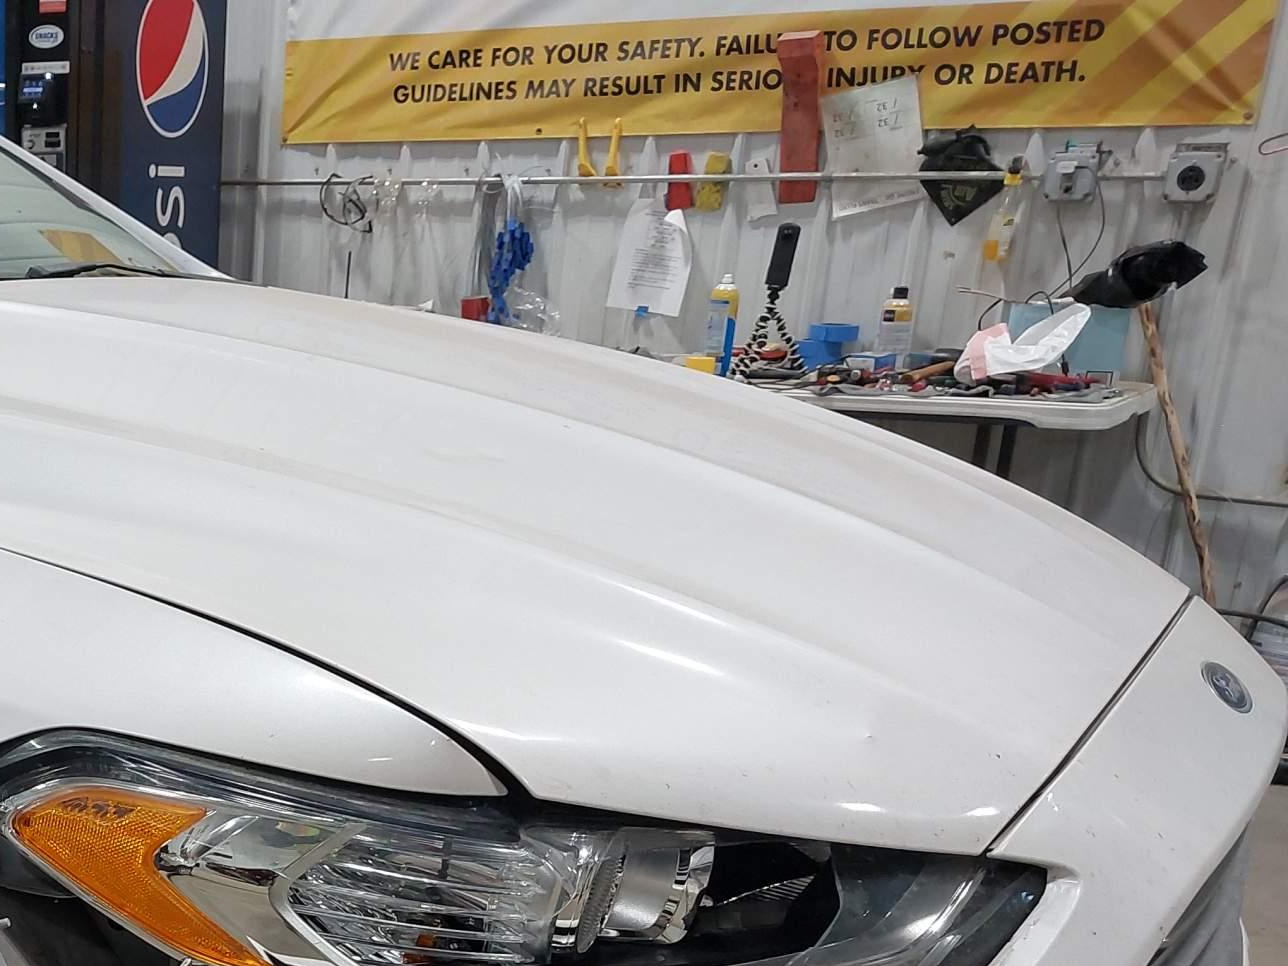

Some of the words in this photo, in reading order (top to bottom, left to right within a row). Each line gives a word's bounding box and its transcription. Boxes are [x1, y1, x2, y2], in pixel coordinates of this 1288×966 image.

[389, 51, 421, 71] WE
[428, 48, 482, 69] CARE
[490, 46, 534, 67] FOR
[544, 42, 608, 65] YOUR
[616, 37, 705, 61] SAFETY.
[715, 33, 781, 56] FAILU
[824, 29, 858, 51] TO
[867, 25, 983, 50] FOLLOW
[992, 19, 1105, 46] POSTED
[393, 80, 517, 103] GUIDELINES
[524, 78, 576, 99] MAY
[583, 74, 665, 97] RESULT
[674, 72, 701, 93] IN
[710, 68, 782, 91] SERIO
[934, 63, 974, 86] OR
[984, 60, 1086, 84] DEATH.
